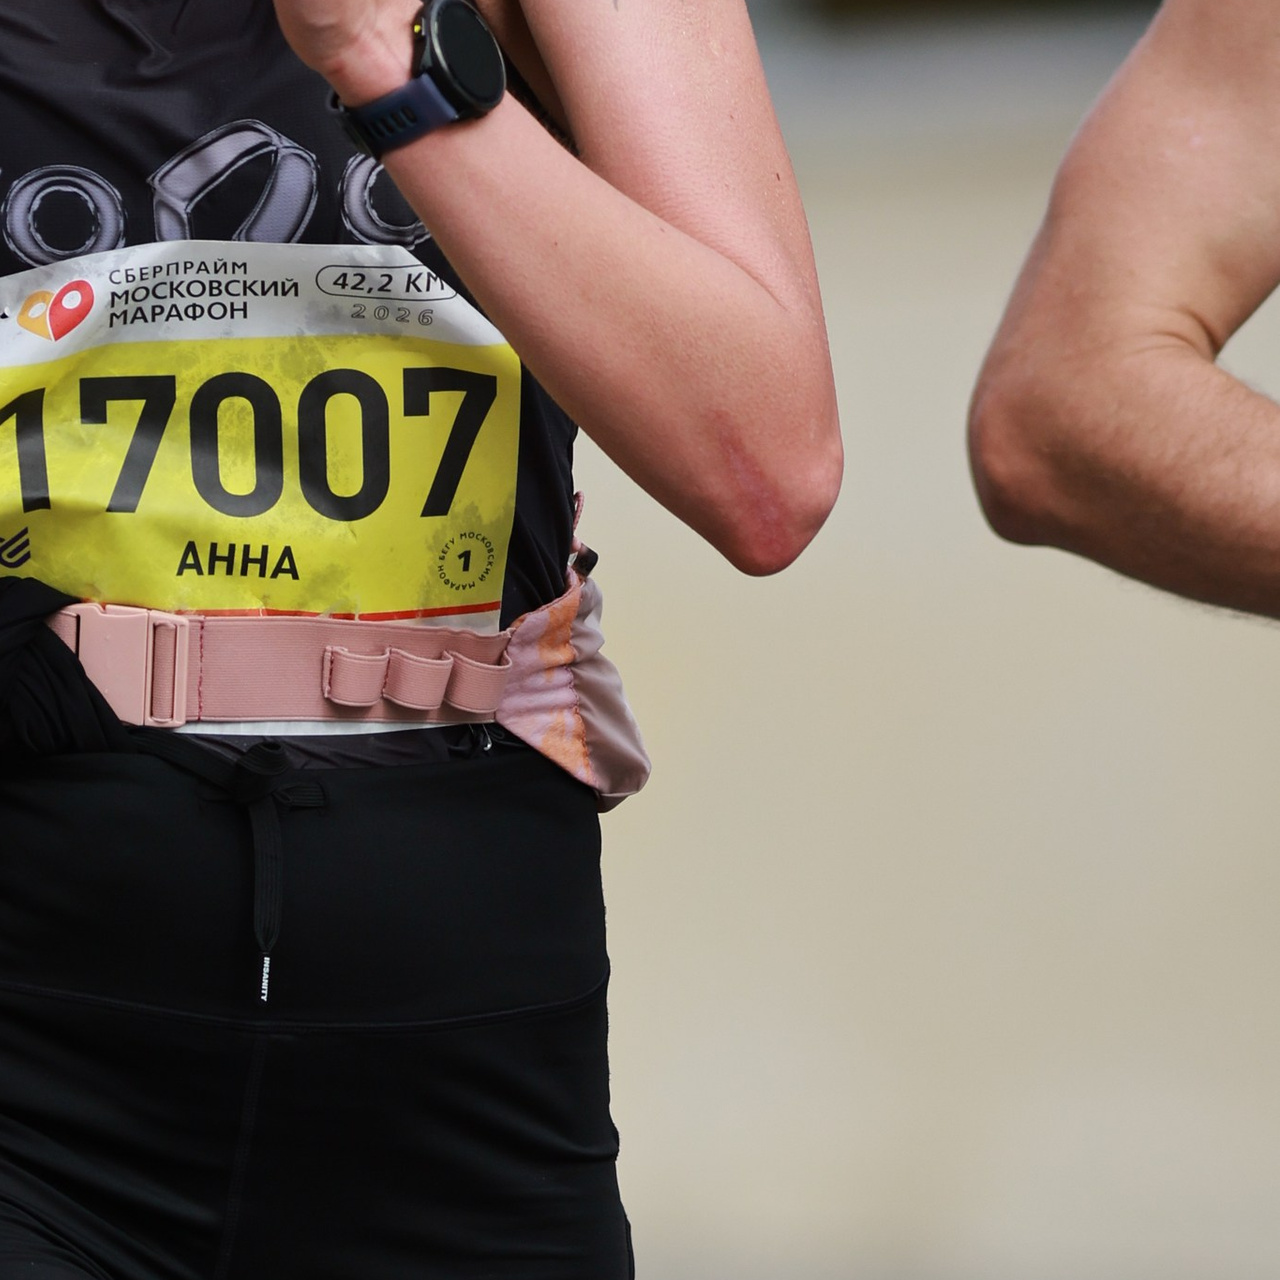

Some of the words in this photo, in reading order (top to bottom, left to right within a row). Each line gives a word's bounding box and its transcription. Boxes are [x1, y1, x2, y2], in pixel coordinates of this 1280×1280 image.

[108, 260, 249, 286] СБЕРПРАЙМ
[332, 272, 394, 295] 42,2
[109, 277, 300, 309] МОСКОВСКИЙ
[108, 300, 249, 329] МАРАФОН
[350, 303, 435, 326] 2026
[176, 540, 300, 581] АННА
[438, 537, 455, 561] БЕГУ
[457, 549, 472, 572] 1
[460, 531, 495, 582] МОСКОВСКИЙ
[437, 564, 476, 591] МАРАФОН
[260, 956, 271, 1002] INSANITY
